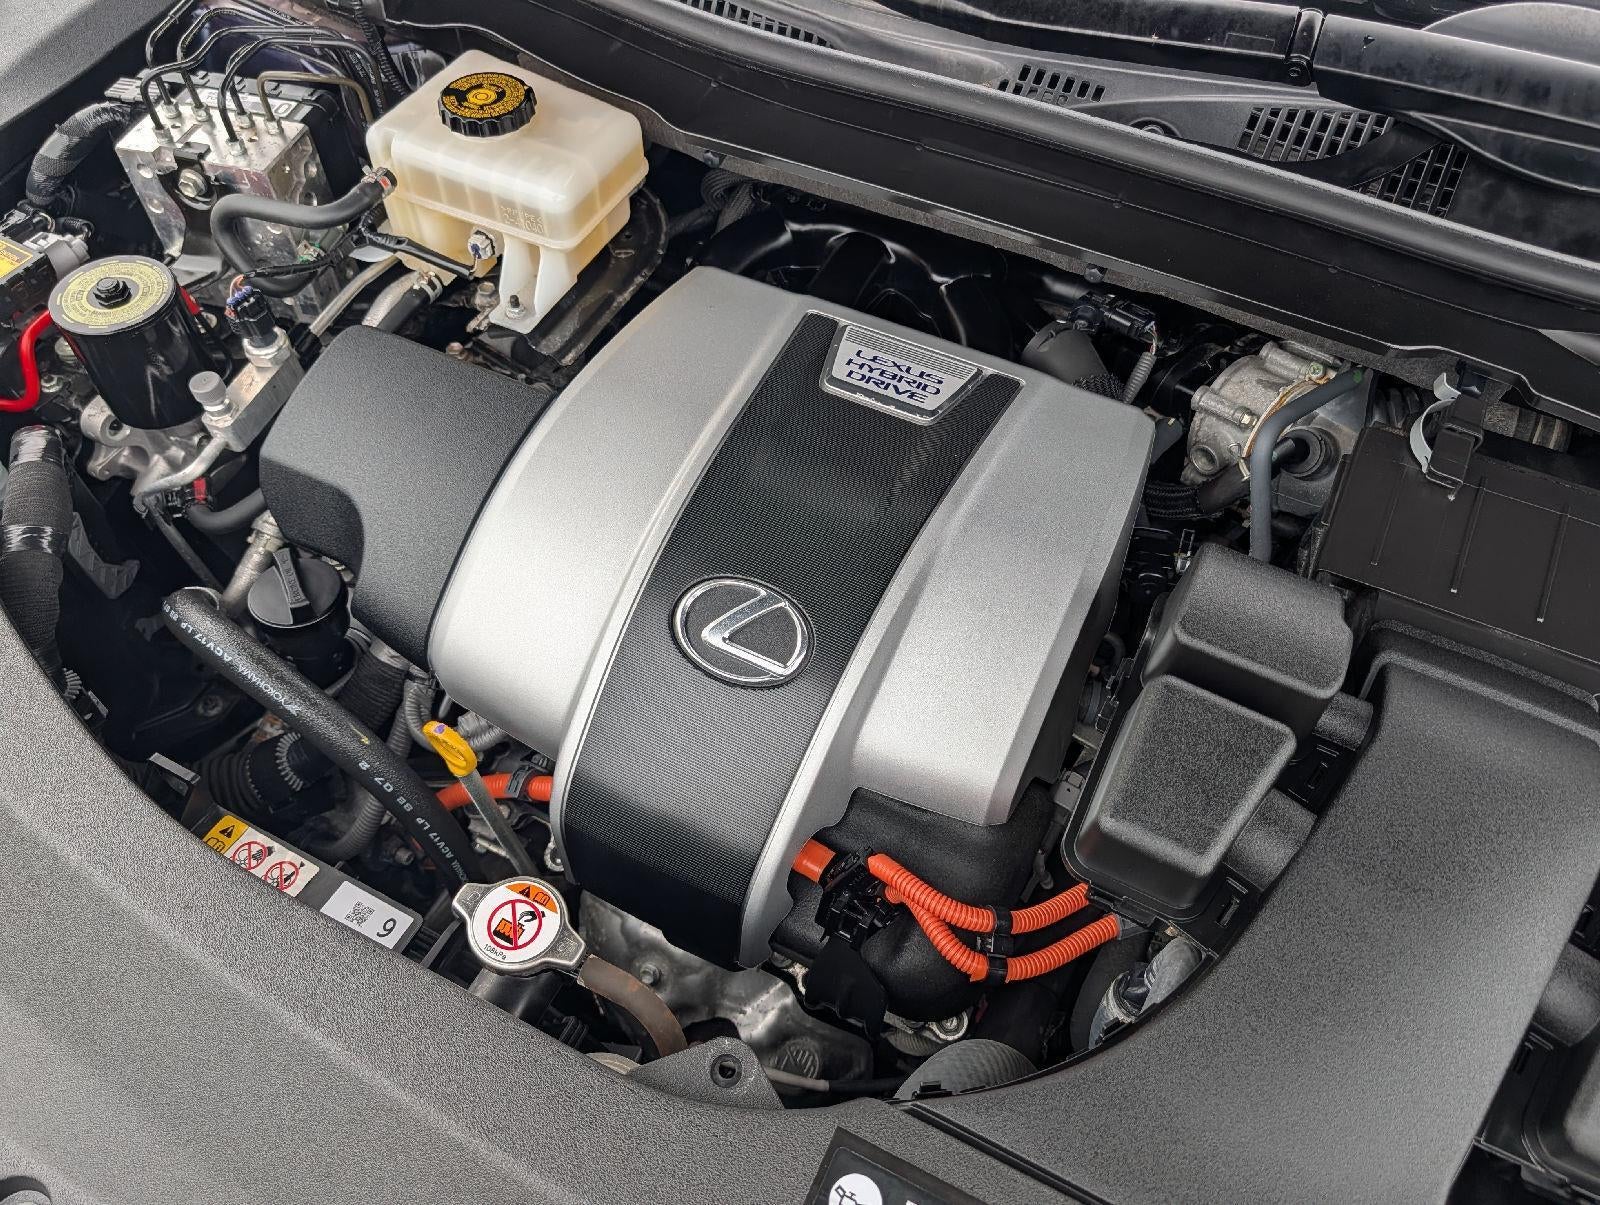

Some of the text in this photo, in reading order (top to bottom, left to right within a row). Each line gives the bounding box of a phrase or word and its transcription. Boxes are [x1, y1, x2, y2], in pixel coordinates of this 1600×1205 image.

[845, 358, 941, 396] HYBRID
[855, 349, 945, 385] LEXUS
[846, 369, 928, 404] DRIVE
[180, 622, 193, 634] LP
[194, 633, 233, 662] ACV17
[239, 664, 287, 706] YOKOHAMA
[358, 760, 371, 771] 2
[416, 817, 431, 831] LP
[429, 832, 454, 859] ACV17
[483, 943, 507, 961] 108kPa
